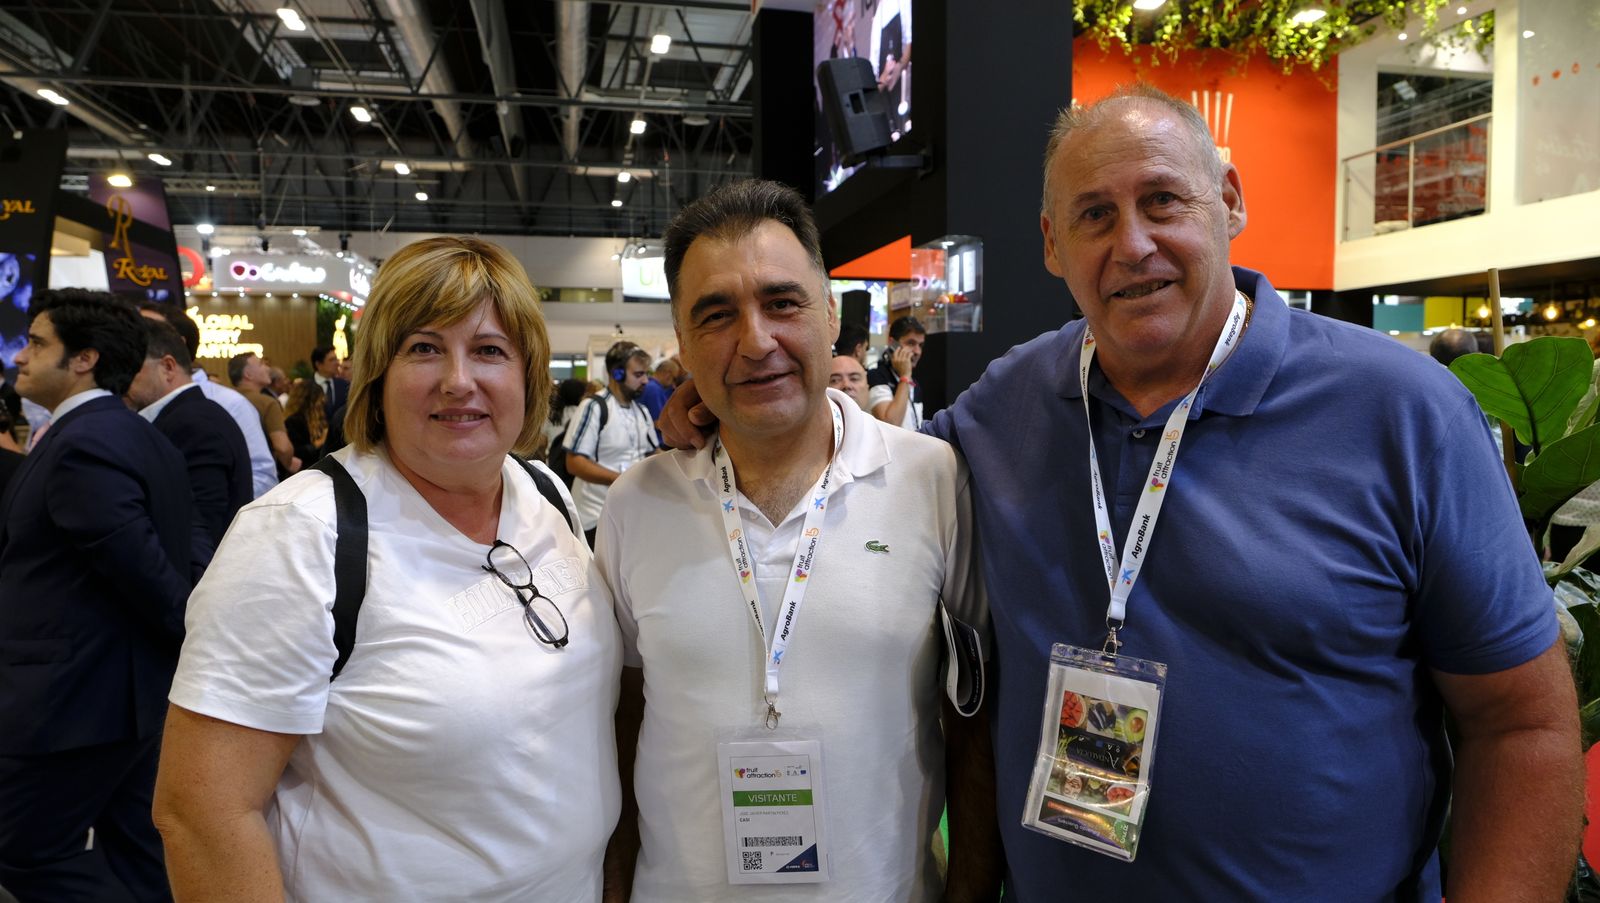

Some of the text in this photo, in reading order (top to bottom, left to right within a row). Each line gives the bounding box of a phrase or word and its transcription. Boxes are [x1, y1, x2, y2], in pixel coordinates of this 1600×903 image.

[1225, 312, 1241, 346] AgroBank
[1153, 462, 1163, 478] fruit
[1160, 441, 1177, 480] attraction
[720, 466, 731, 493] AgroBank
[737, 537, 748, 568] attraction
[1131, 514, 1151, 559] AgroBank
[797, 555, 805, 568] fruit
[804, 537, 817, 571] attraction
[781, 601, 797, 641] AgroBank
[747, 793, 797, 803] VISITANTE
